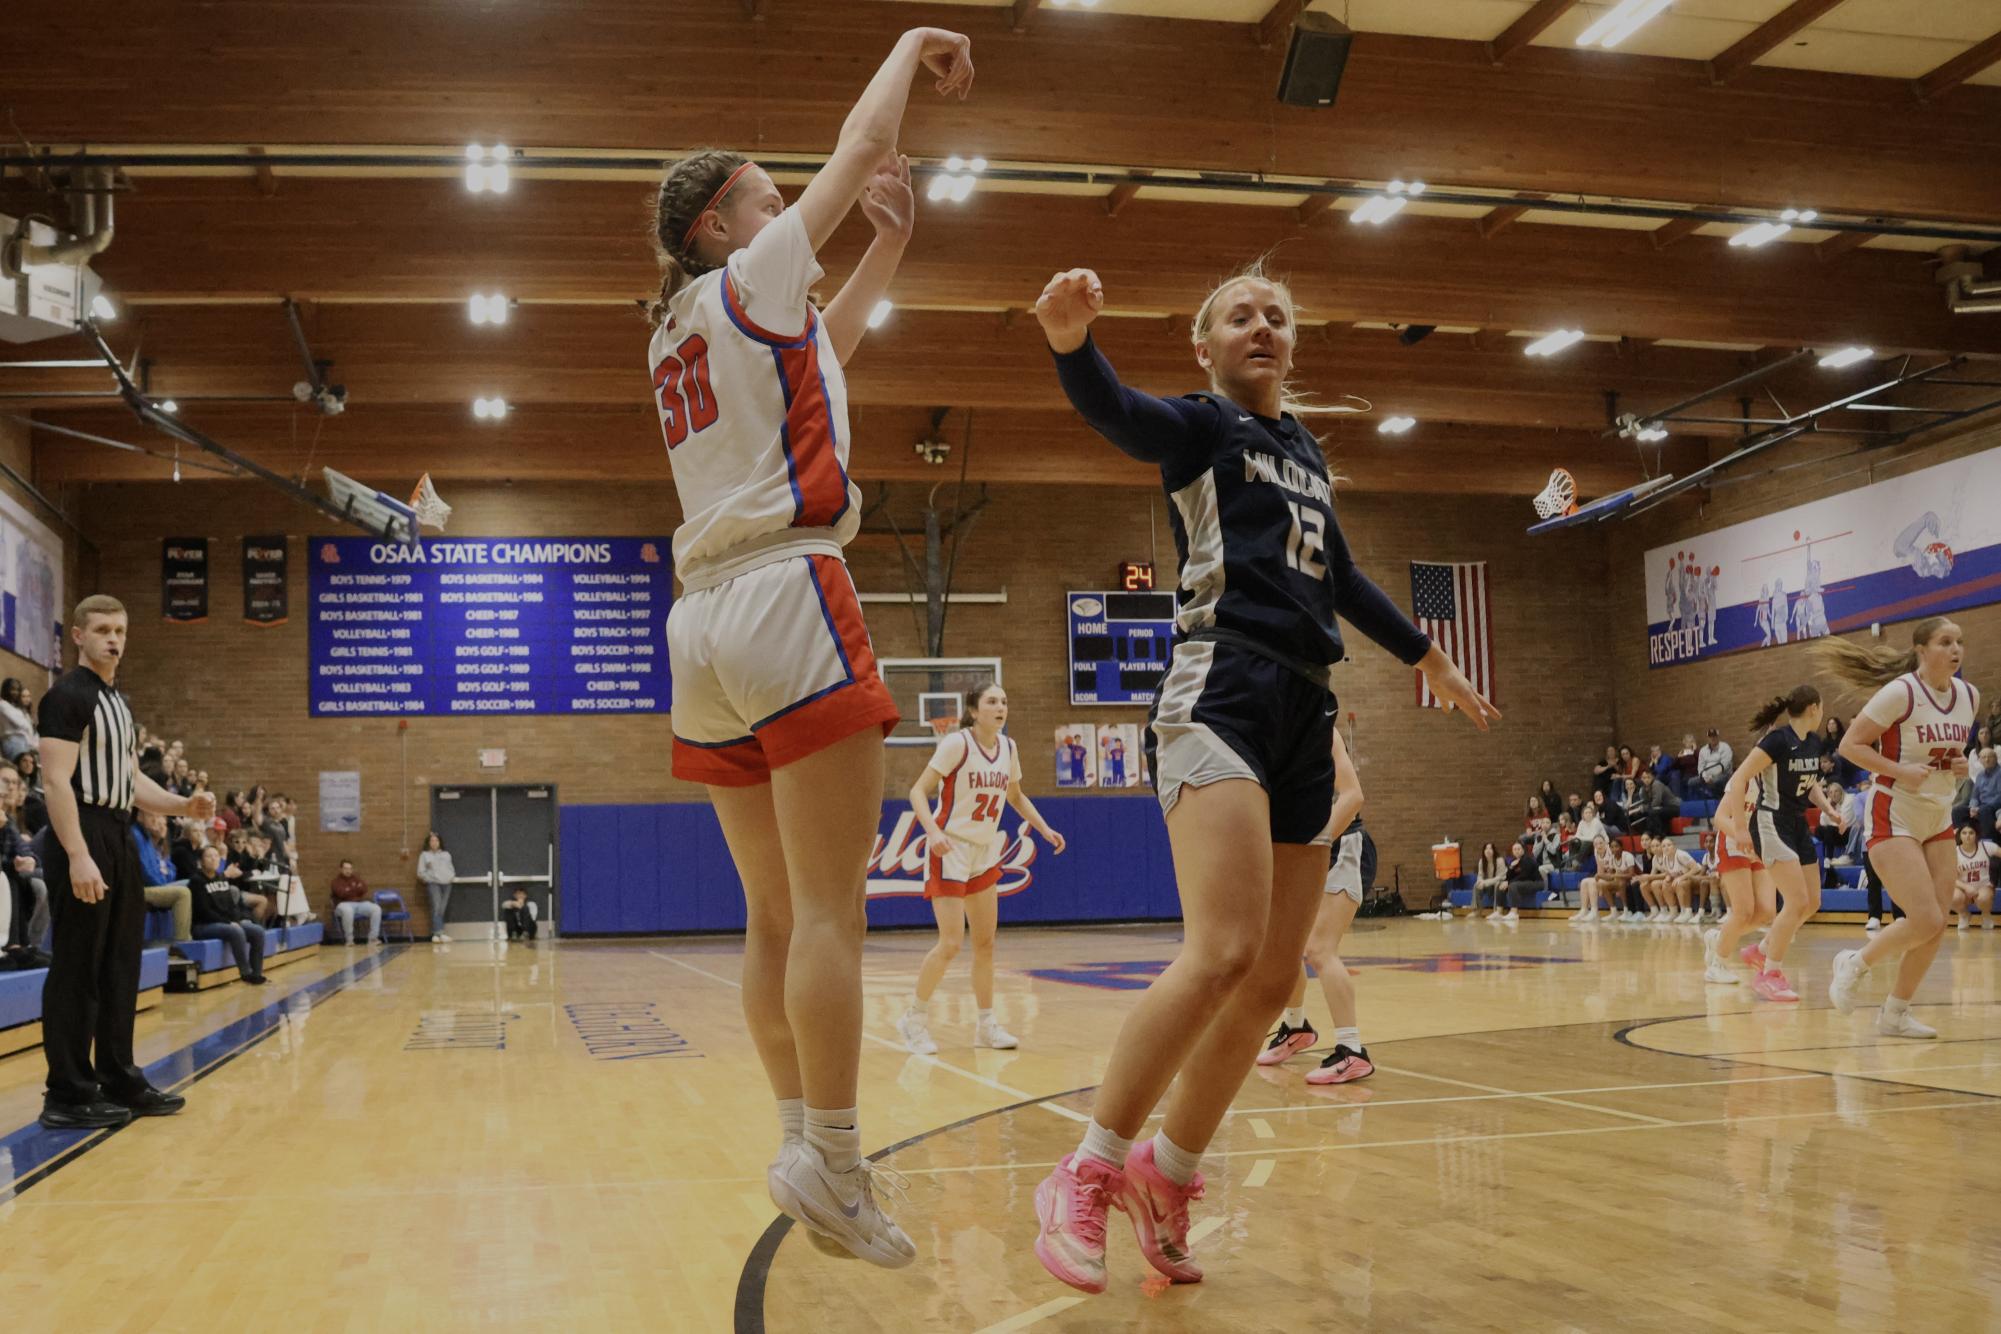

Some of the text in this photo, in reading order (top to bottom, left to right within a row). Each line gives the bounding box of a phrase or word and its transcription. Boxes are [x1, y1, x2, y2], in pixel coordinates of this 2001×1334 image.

[653, 332, 720, 450] 30
[1286, 500, 1327, 582] 12
[370, 544, 611, 564] OSAA STATE CHAMPIONS
[330, 574, 354, 585] BOYS
[440, 574, 464, 584] BOYS
[1126, 566, 1152, 589] 24
[319, 592, 345, 603] GIRLS
[440, 592, 464, 602] BOYS
[320, 610, 344, 621] BOYS
[573, 627, 598, 638] BOYS
[1077, 623, 1108, 635] HOME
[1128, 628, 1154, 638] PERIOD
[456, 646, 480, 656] BOYS
[571, 645, 595, 656] BOYS
[1650, 626, 1700, 665] RESPECT
[330, 646, 356, 657] GIRLS
[320, 664, 344, 675] BOYS
[456, 664, 480, 674] BOYS
[575, 663, 600, 673] GIRLS
[1073, 662, 1097, 671] FOULS
[1119, 662, 1146, 672] PLAYER
[457, 682, 481, 693] BOYS
[1074, 693, 1098, 702] SCORE
[319, 700, 345, 711] GIRLS
[451, 700, 475, 710] BOYS
[572, 698, 596, 709] BOYS
[971, 793, 1000, 823] 24
